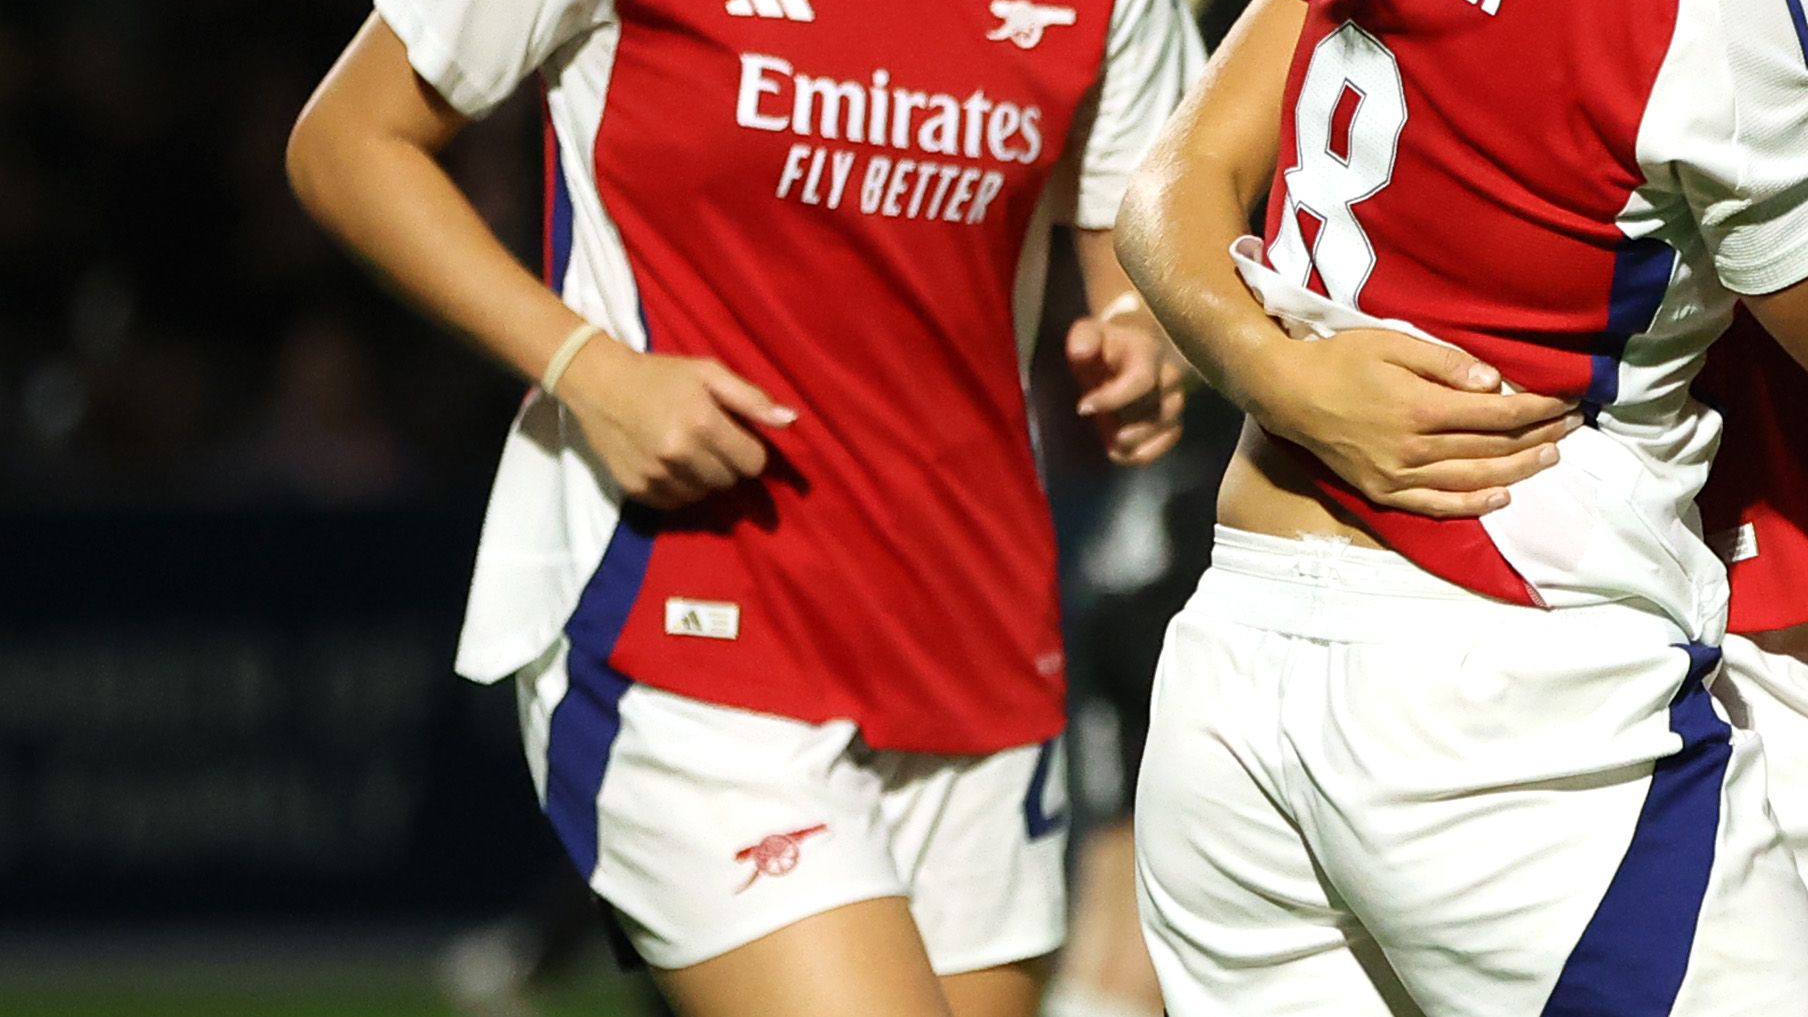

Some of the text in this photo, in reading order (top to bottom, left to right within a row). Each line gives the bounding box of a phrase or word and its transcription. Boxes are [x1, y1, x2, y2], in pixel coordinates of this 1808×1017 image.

[736, 51, 1043, 164] Emirates
[776, 143, 1005, 225] FLY BETTER
[1266, 18, 1409, 312] 8
